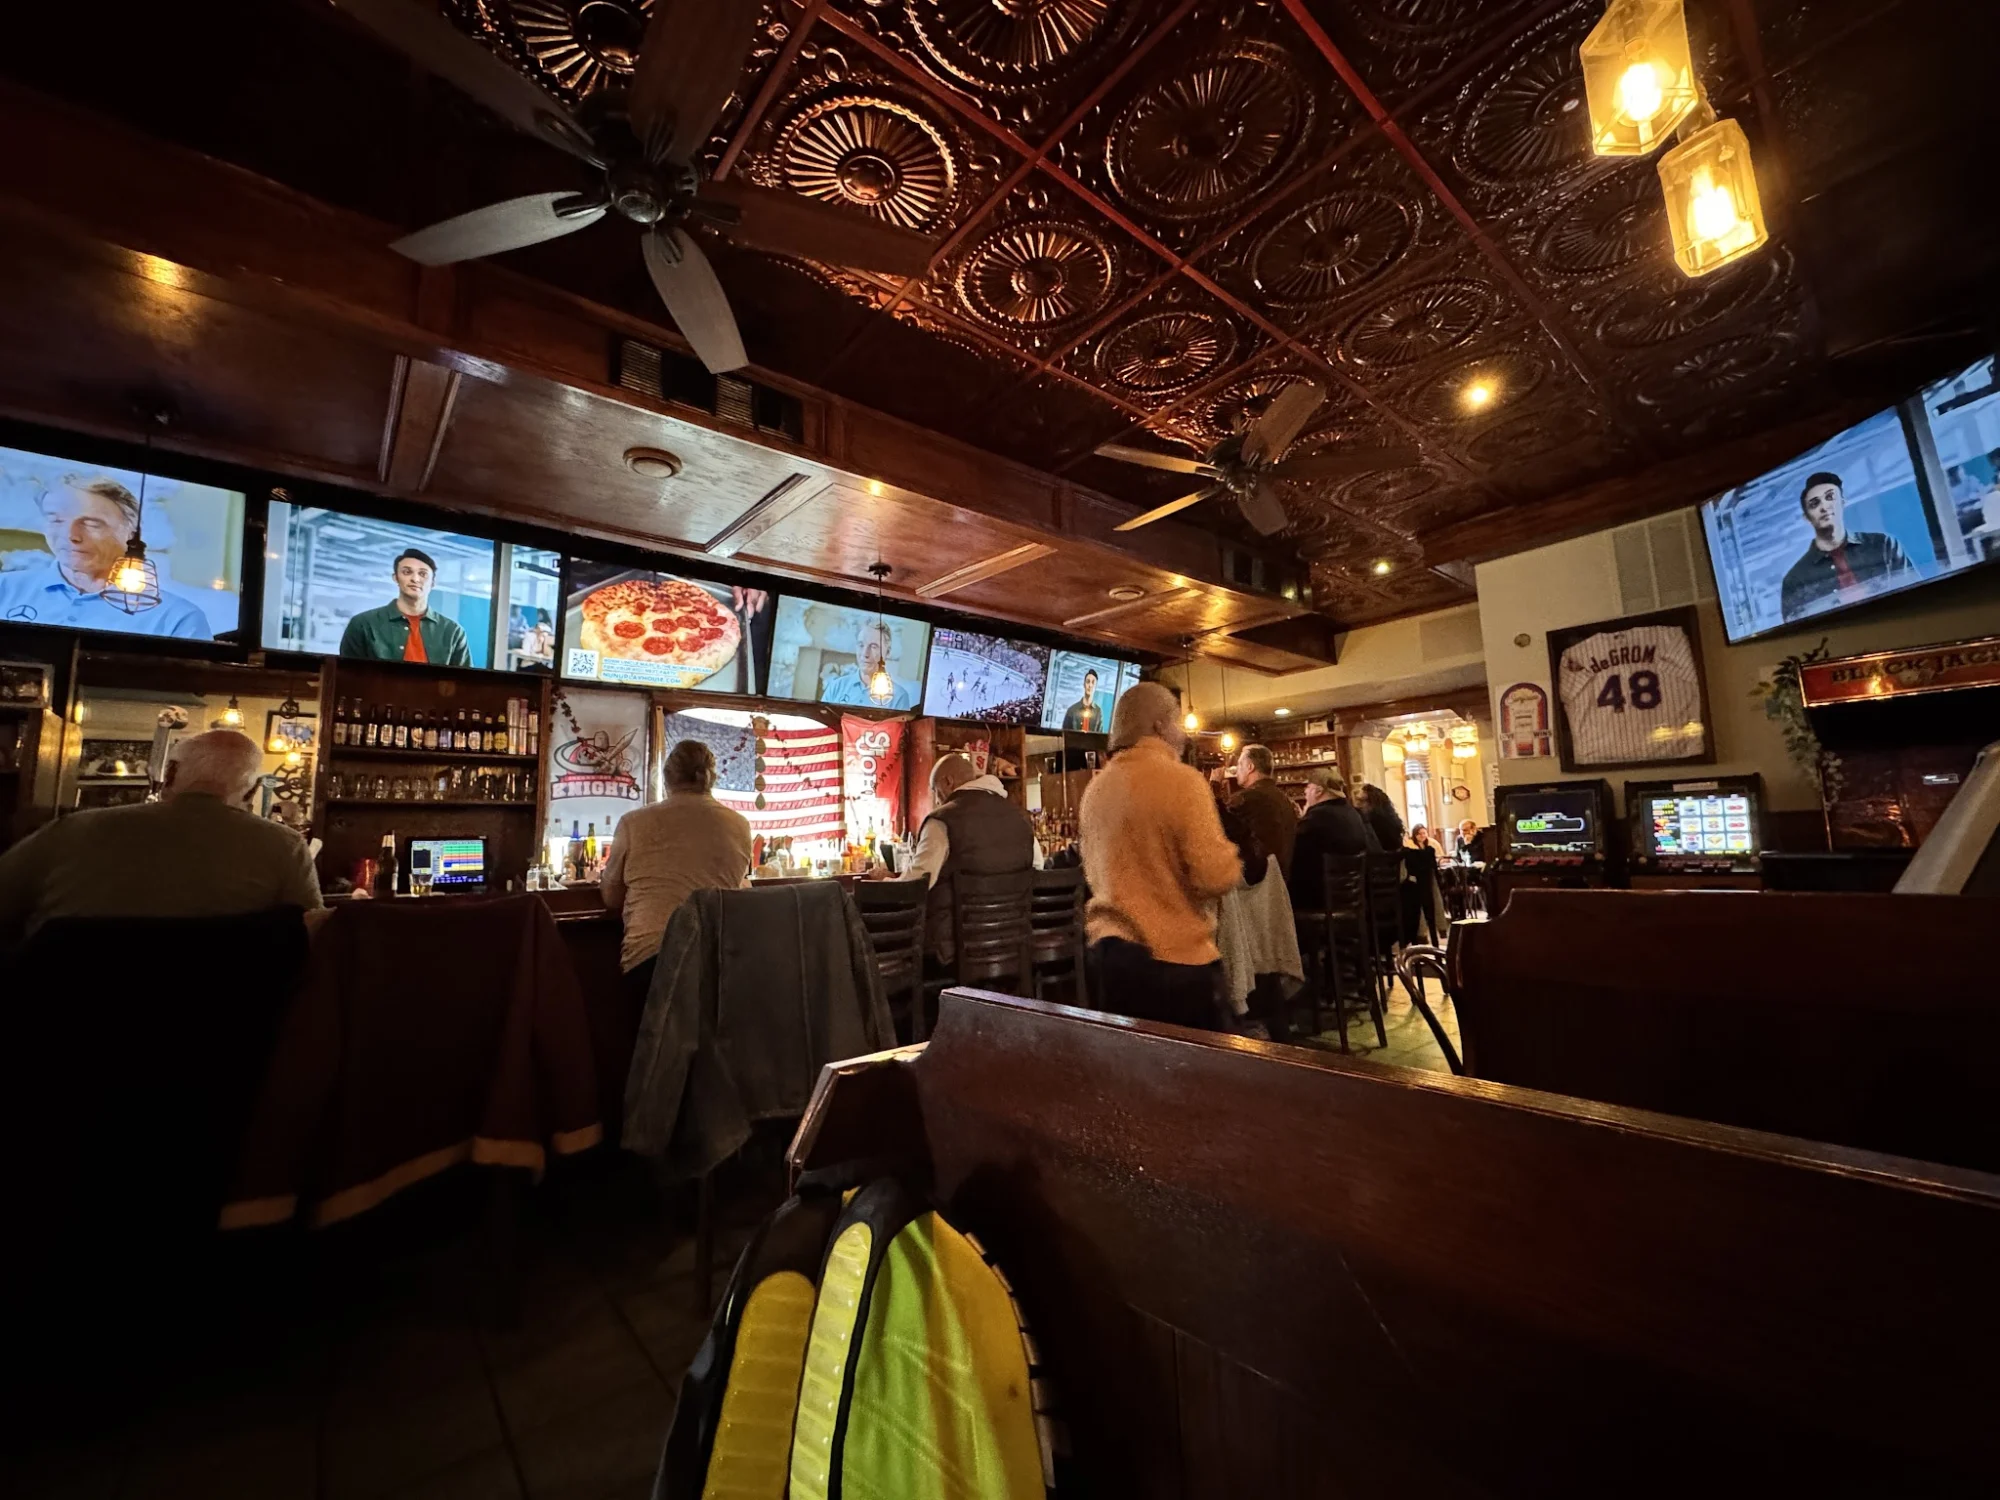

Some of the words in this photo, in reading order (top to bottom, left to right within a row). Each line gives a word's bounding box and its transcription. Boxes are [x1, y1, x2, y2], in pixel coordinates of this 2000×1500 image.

[1590, 645, 1656, 674] deGROM
[1832, 658, 1926, 682] BLACK
[1597, 670, 1662, 713] 48
[552, 781, 640, 799] KNIGHTS
